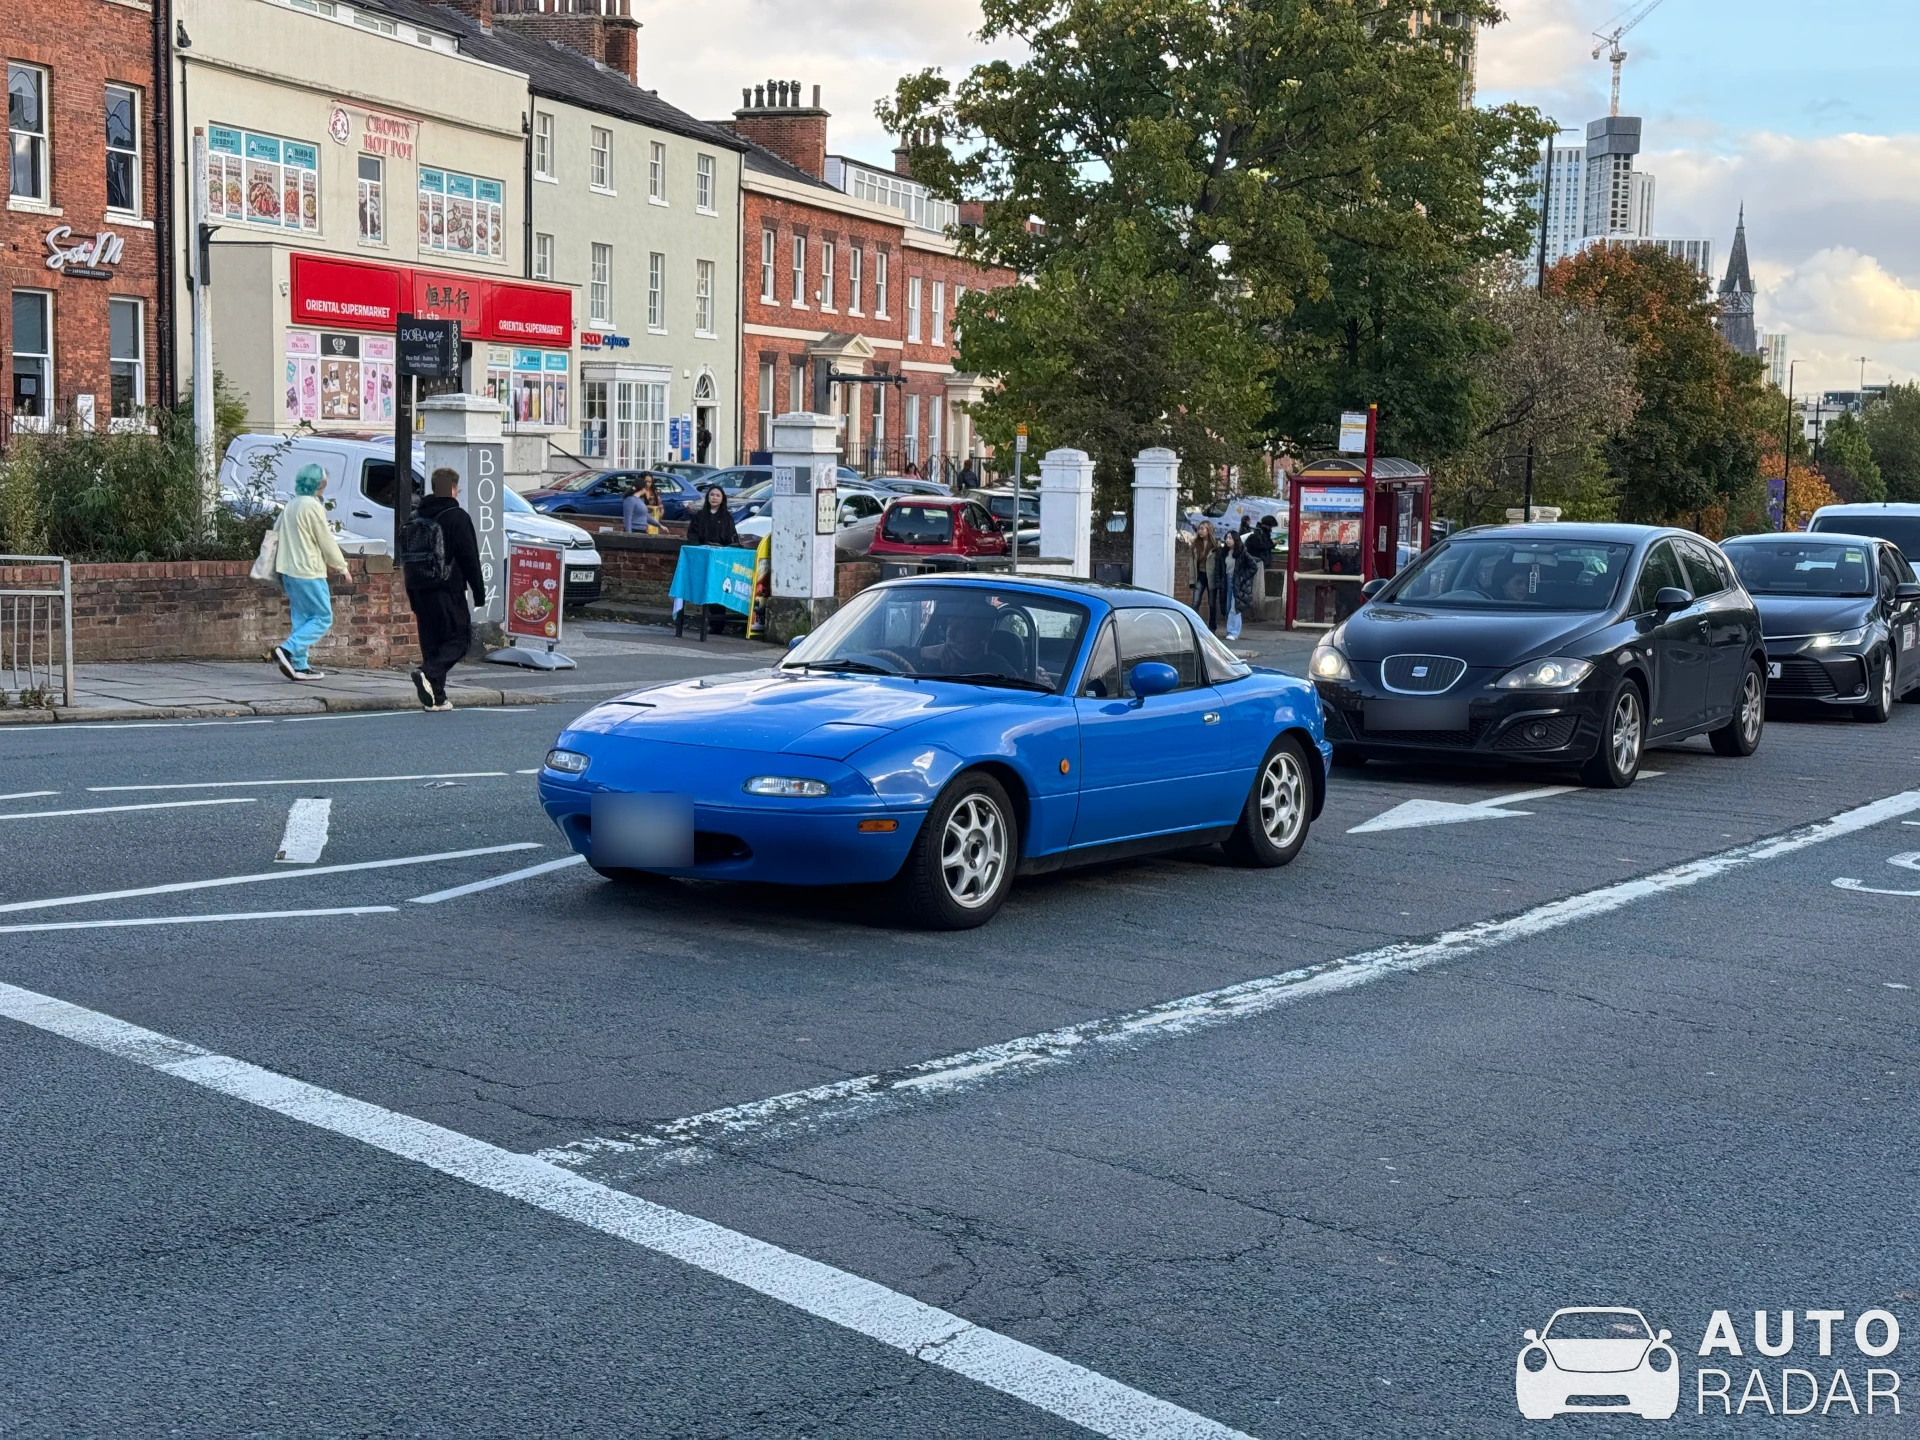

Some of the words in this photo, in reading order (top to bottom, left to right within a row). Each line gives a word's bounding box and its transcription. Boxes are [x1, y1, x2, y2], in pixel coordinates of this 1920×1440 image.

[366, 115, 410, 140] CROWN
[257, 143, 277, 154] Fantuan
[363, 134, 388, 155] HOT
[390, 140, 413, 160] POT
[305, 298, 340, 313] ORIENTAL
[340, 302, 391, 318] SUPERMARKET
[498, 319, 525, 332] ORIENTAL
[525, 322, 564, 336] SUPERMARKET
[581, 332, 602, 346] ESCO
[602, 334, 630, 351] express
